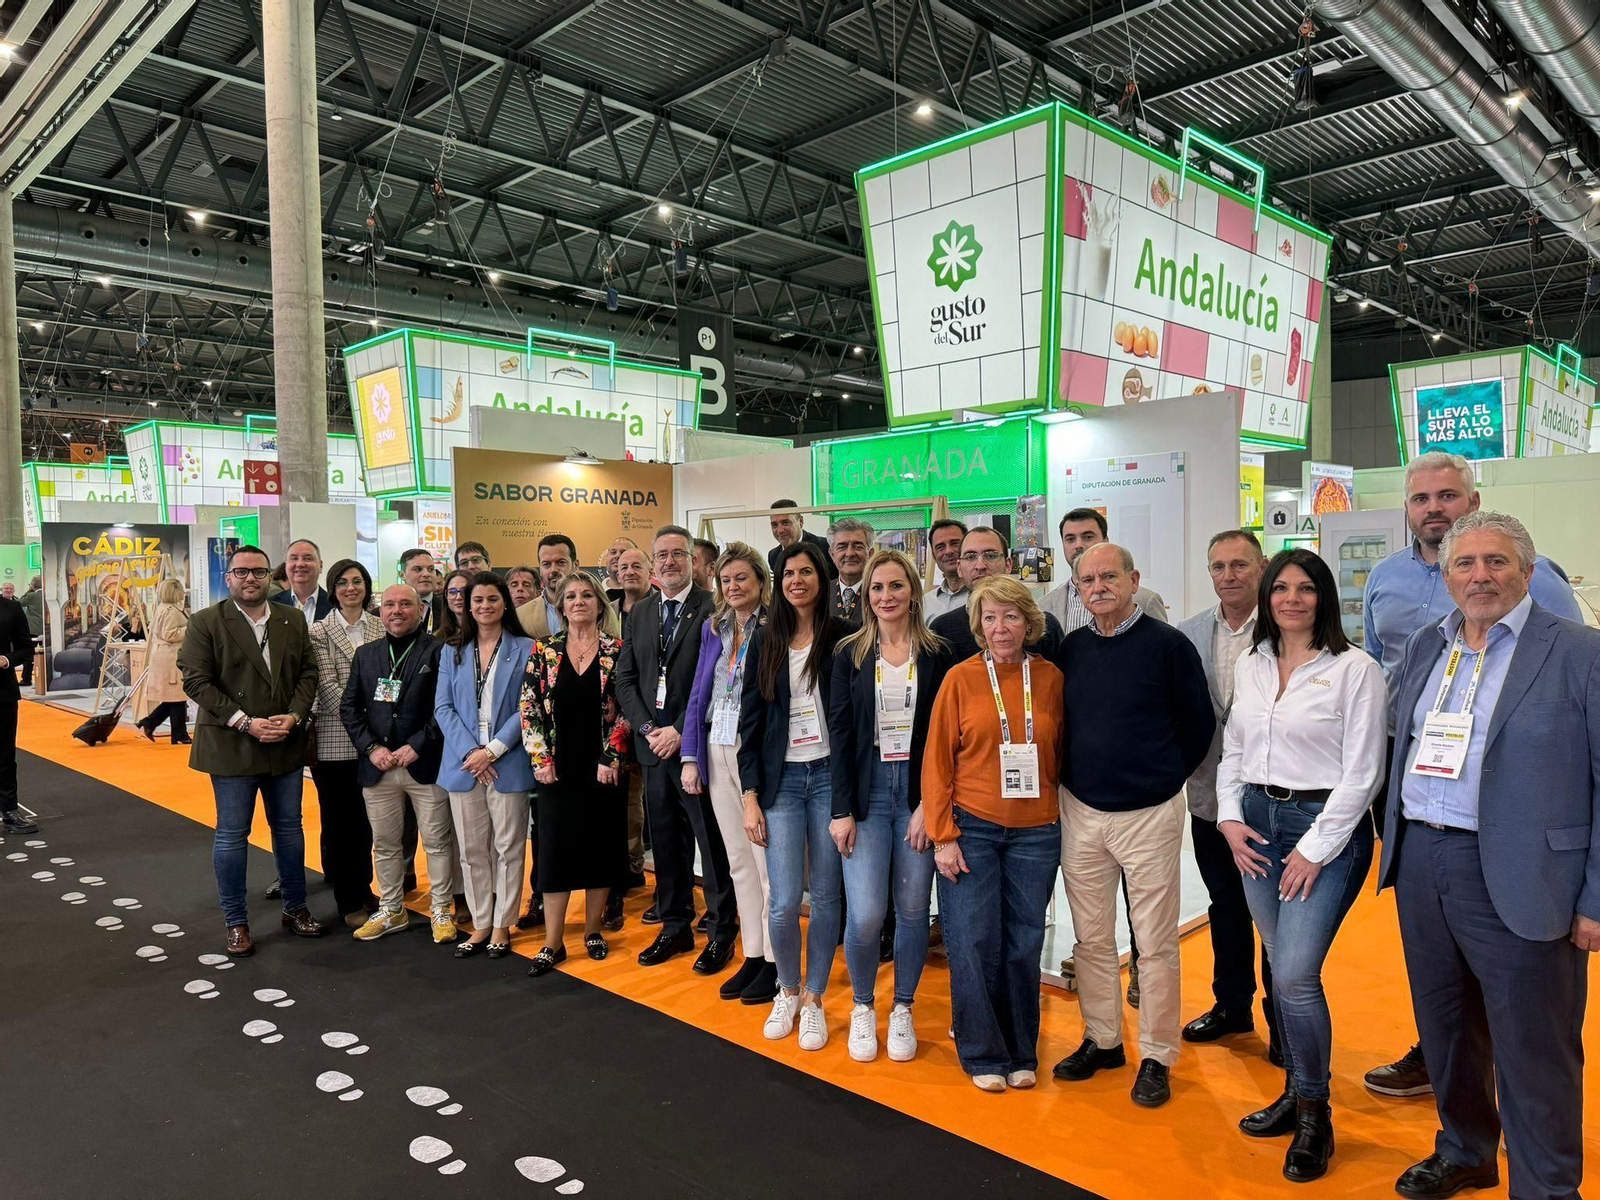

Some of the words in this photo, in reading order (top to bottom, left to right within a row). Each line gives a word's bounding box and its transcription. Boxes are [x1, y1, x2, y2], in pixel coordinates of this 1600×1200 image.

[1134, 237, 1279, 333] Andalucía
[930, 294, 986, 333] gusto
[701, 333, 713, 345] P1
[934, 331, 948, 345] del
[948, 320, 987, 346] Sur
[690, 354, 728, 416] B
[1427, 405, 1470, 420] LLEVA
[1473, 403, 1491, 415] EL
[1428, 418, 1456, 431] SUR
[1458, 417, 1469, 428] A
[1471, 415, 1491, 427] LO
[1541, 400, 1580, 438] Andalucía
[1425, 428, 1455, 443] MÁS
[1458, 426, 1494, 440] ALTO
[841, 445, 988, 488] GRANADA
[474, 482, 553, 503] SABOR
[559, 486, 658, 507] GRANADA
[1081, 480, 1122, 490] DIPUTACIÓN
[1132, 476, 1166, 485] GRANADA
[475, 516, 489, 525] En
[492, 517, 530, 526] conexión
[502, 529, 535, 537] nuestra
[72, 532, 162, 556] CÁDIZ
[1446, 650, 1460, 677] HOSTELCO
